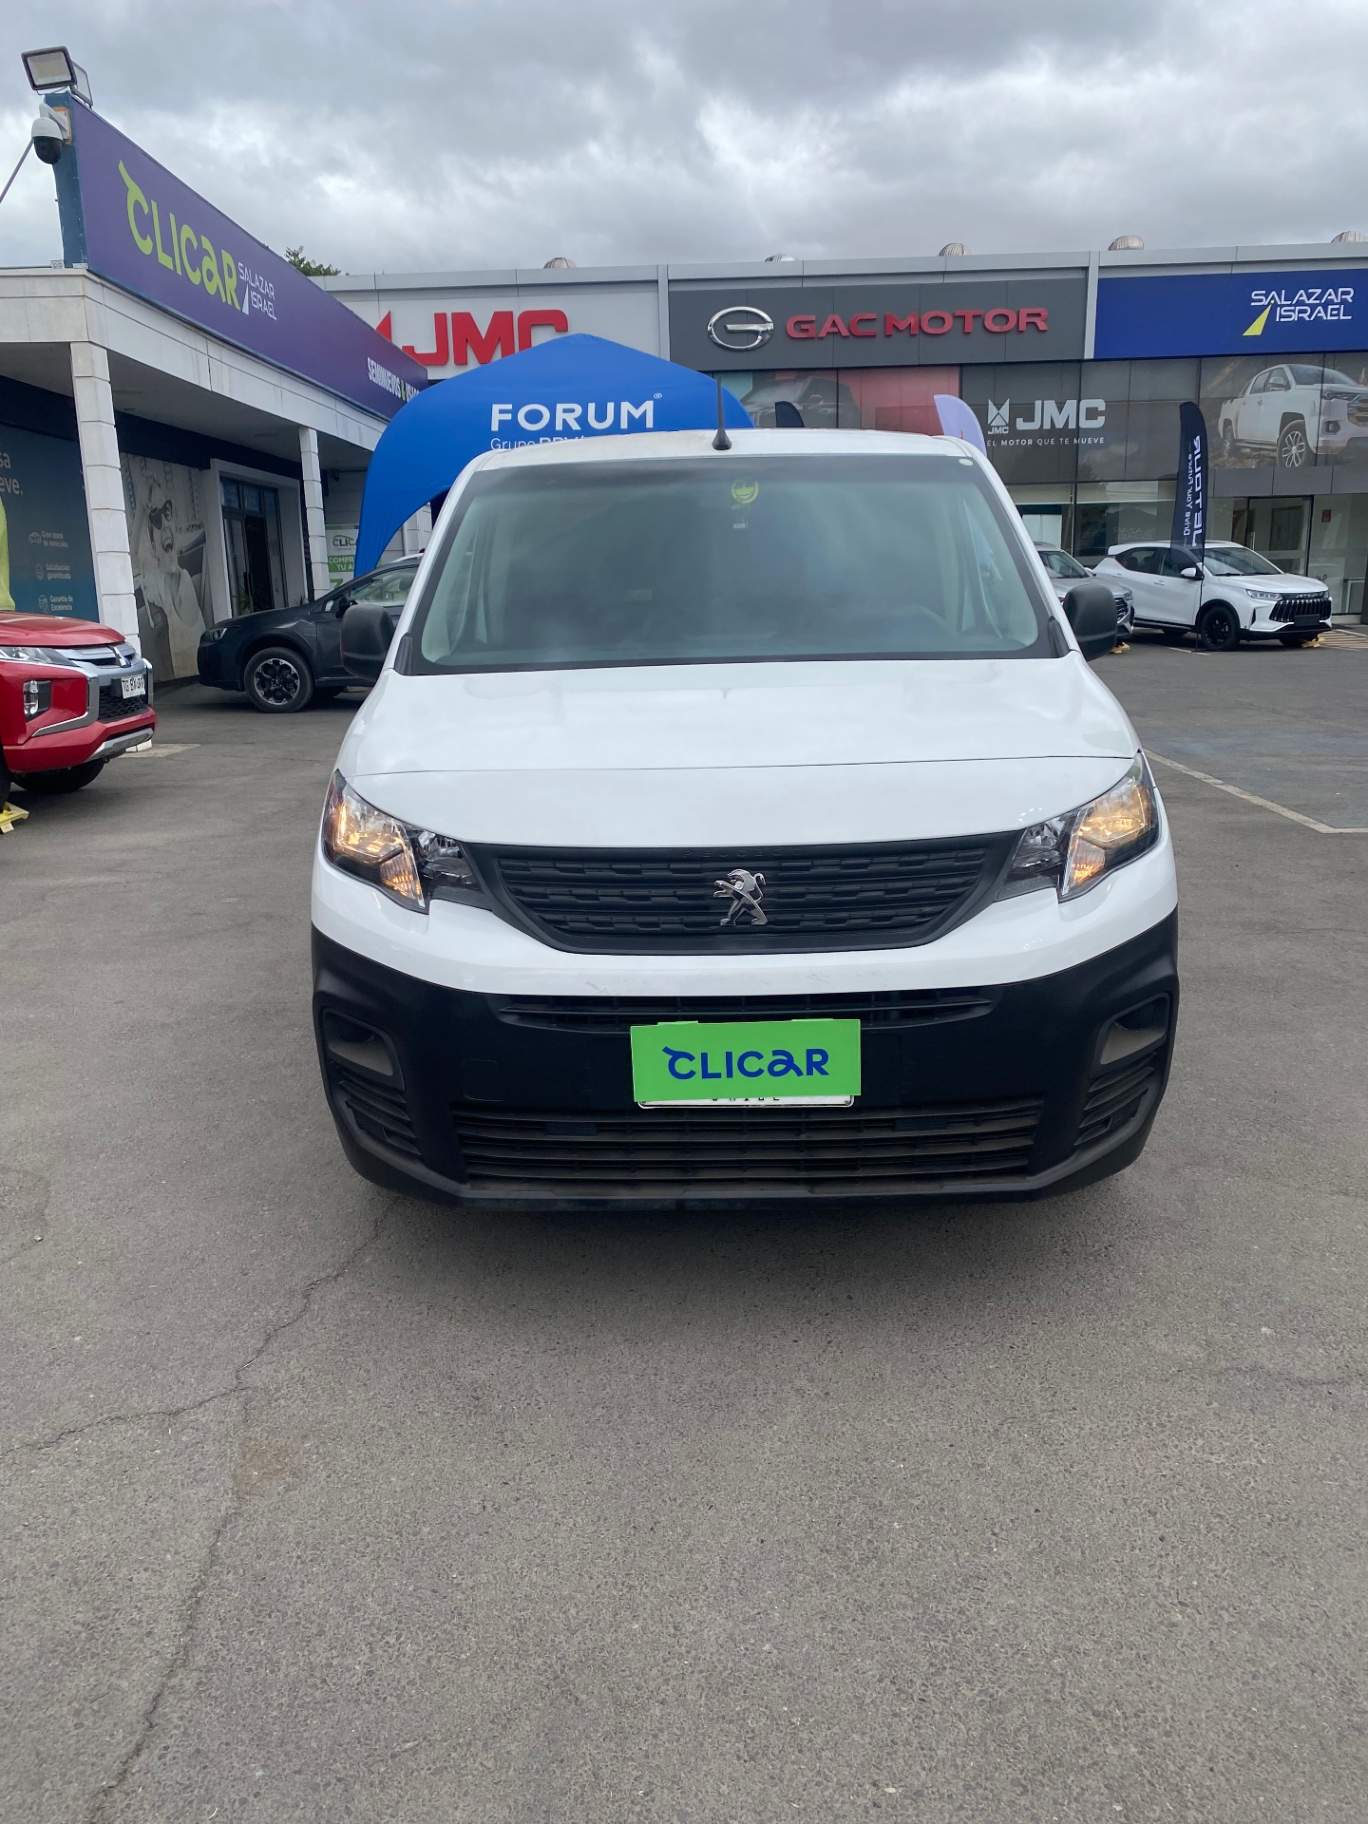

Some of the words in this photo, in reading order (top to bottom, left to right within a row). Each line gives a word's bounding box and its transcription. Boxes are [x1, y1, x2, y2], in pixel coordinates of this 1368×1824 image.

[238, 262, 275, 300] SALAZAR
[251, 290, 277, 320] ISRAEL
[1251, 288, 1354, 306] SALAZAR
[785, 314, 878, 339] GAC
[884, 308, 1049, 337] MOTOR
[1276, 305, 1352, 322] ISRAEL
[402, 309, 569, 367] JMC
[491, 400, 654, 432] FORUM
[1016, 399, 1106, 430] JMC
[1001, 438, 1033, 446] MOTOR
[1037, 437, 1055, 446] QUE
[1060, 437, 1070, 445] TE
[1074, 436, 1105, 445] MUEVE
